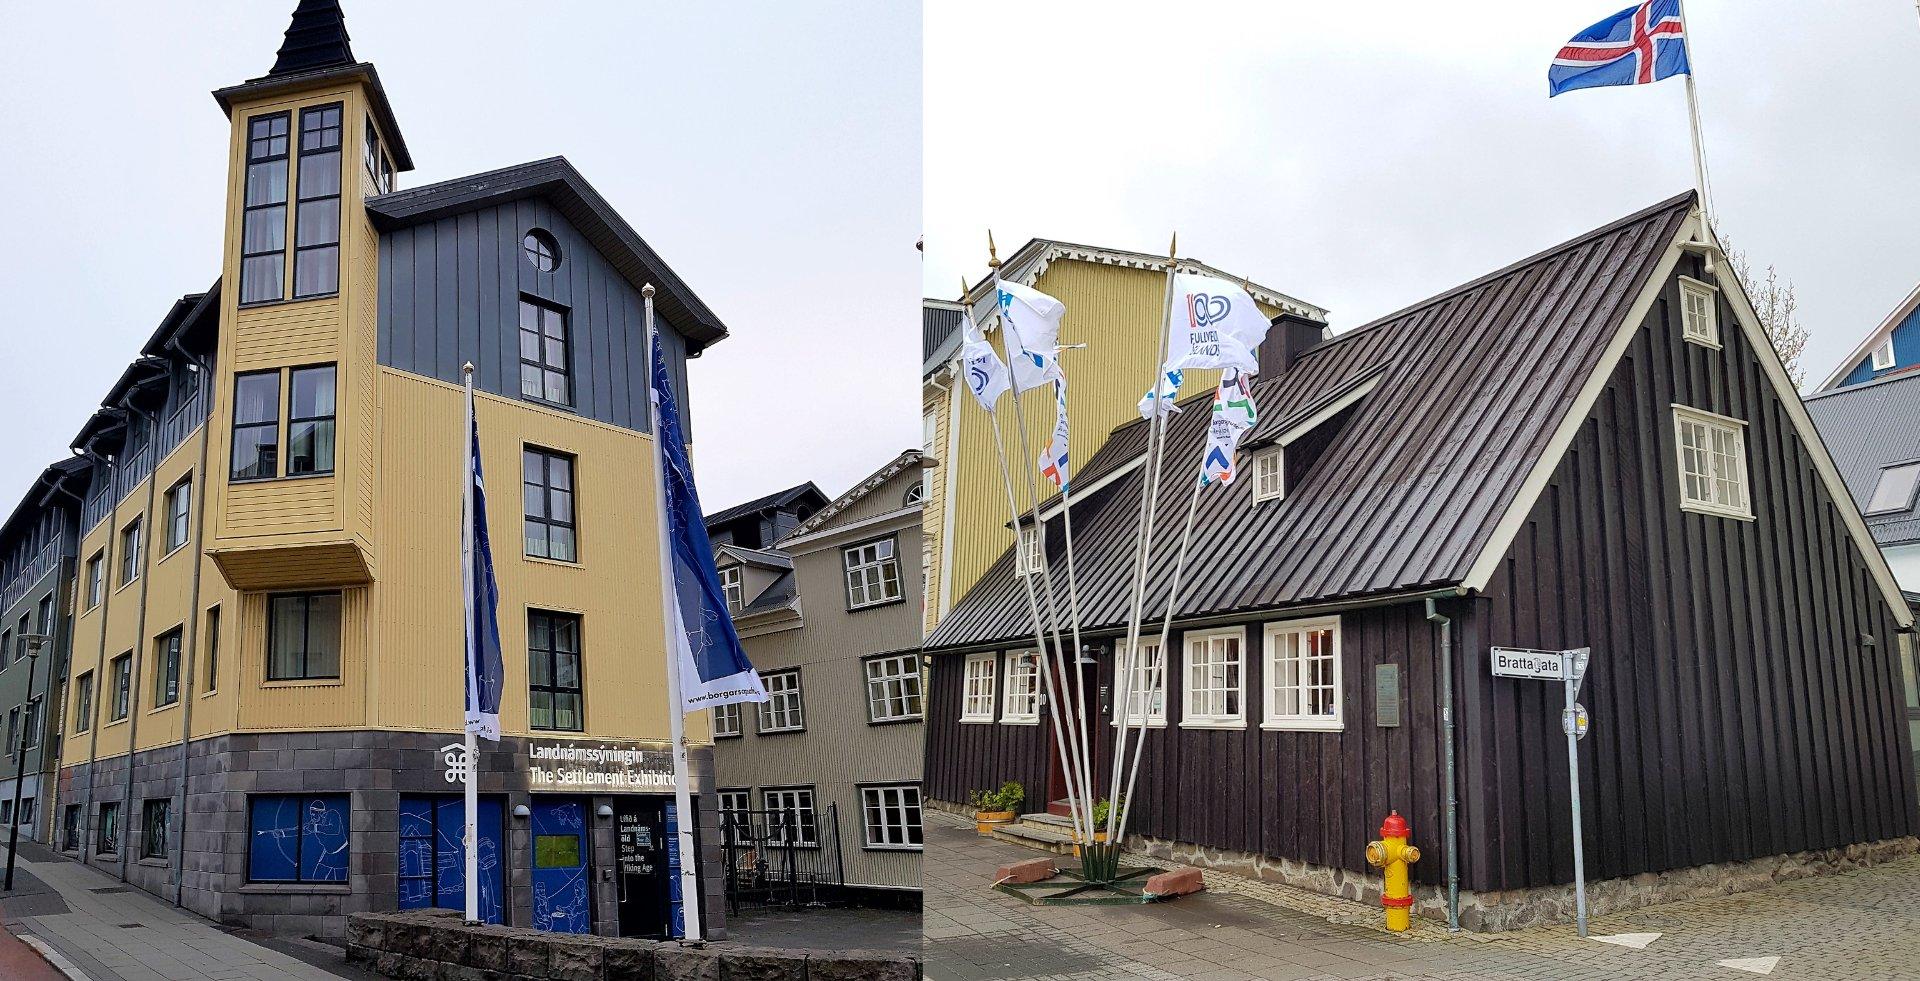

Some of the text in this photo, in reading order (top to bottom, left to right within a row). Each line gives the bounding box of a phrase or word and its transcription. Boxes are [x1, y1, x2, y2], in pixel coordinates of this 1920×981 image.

[529, 742, 643, 765] Landnámssýningin
[530, 766, 677, 786] The Settlement Exhibitio
[621, 844, 635, 854] Step
[634, 854, 645, 862] the
[641, 863, 653, 873] Age
